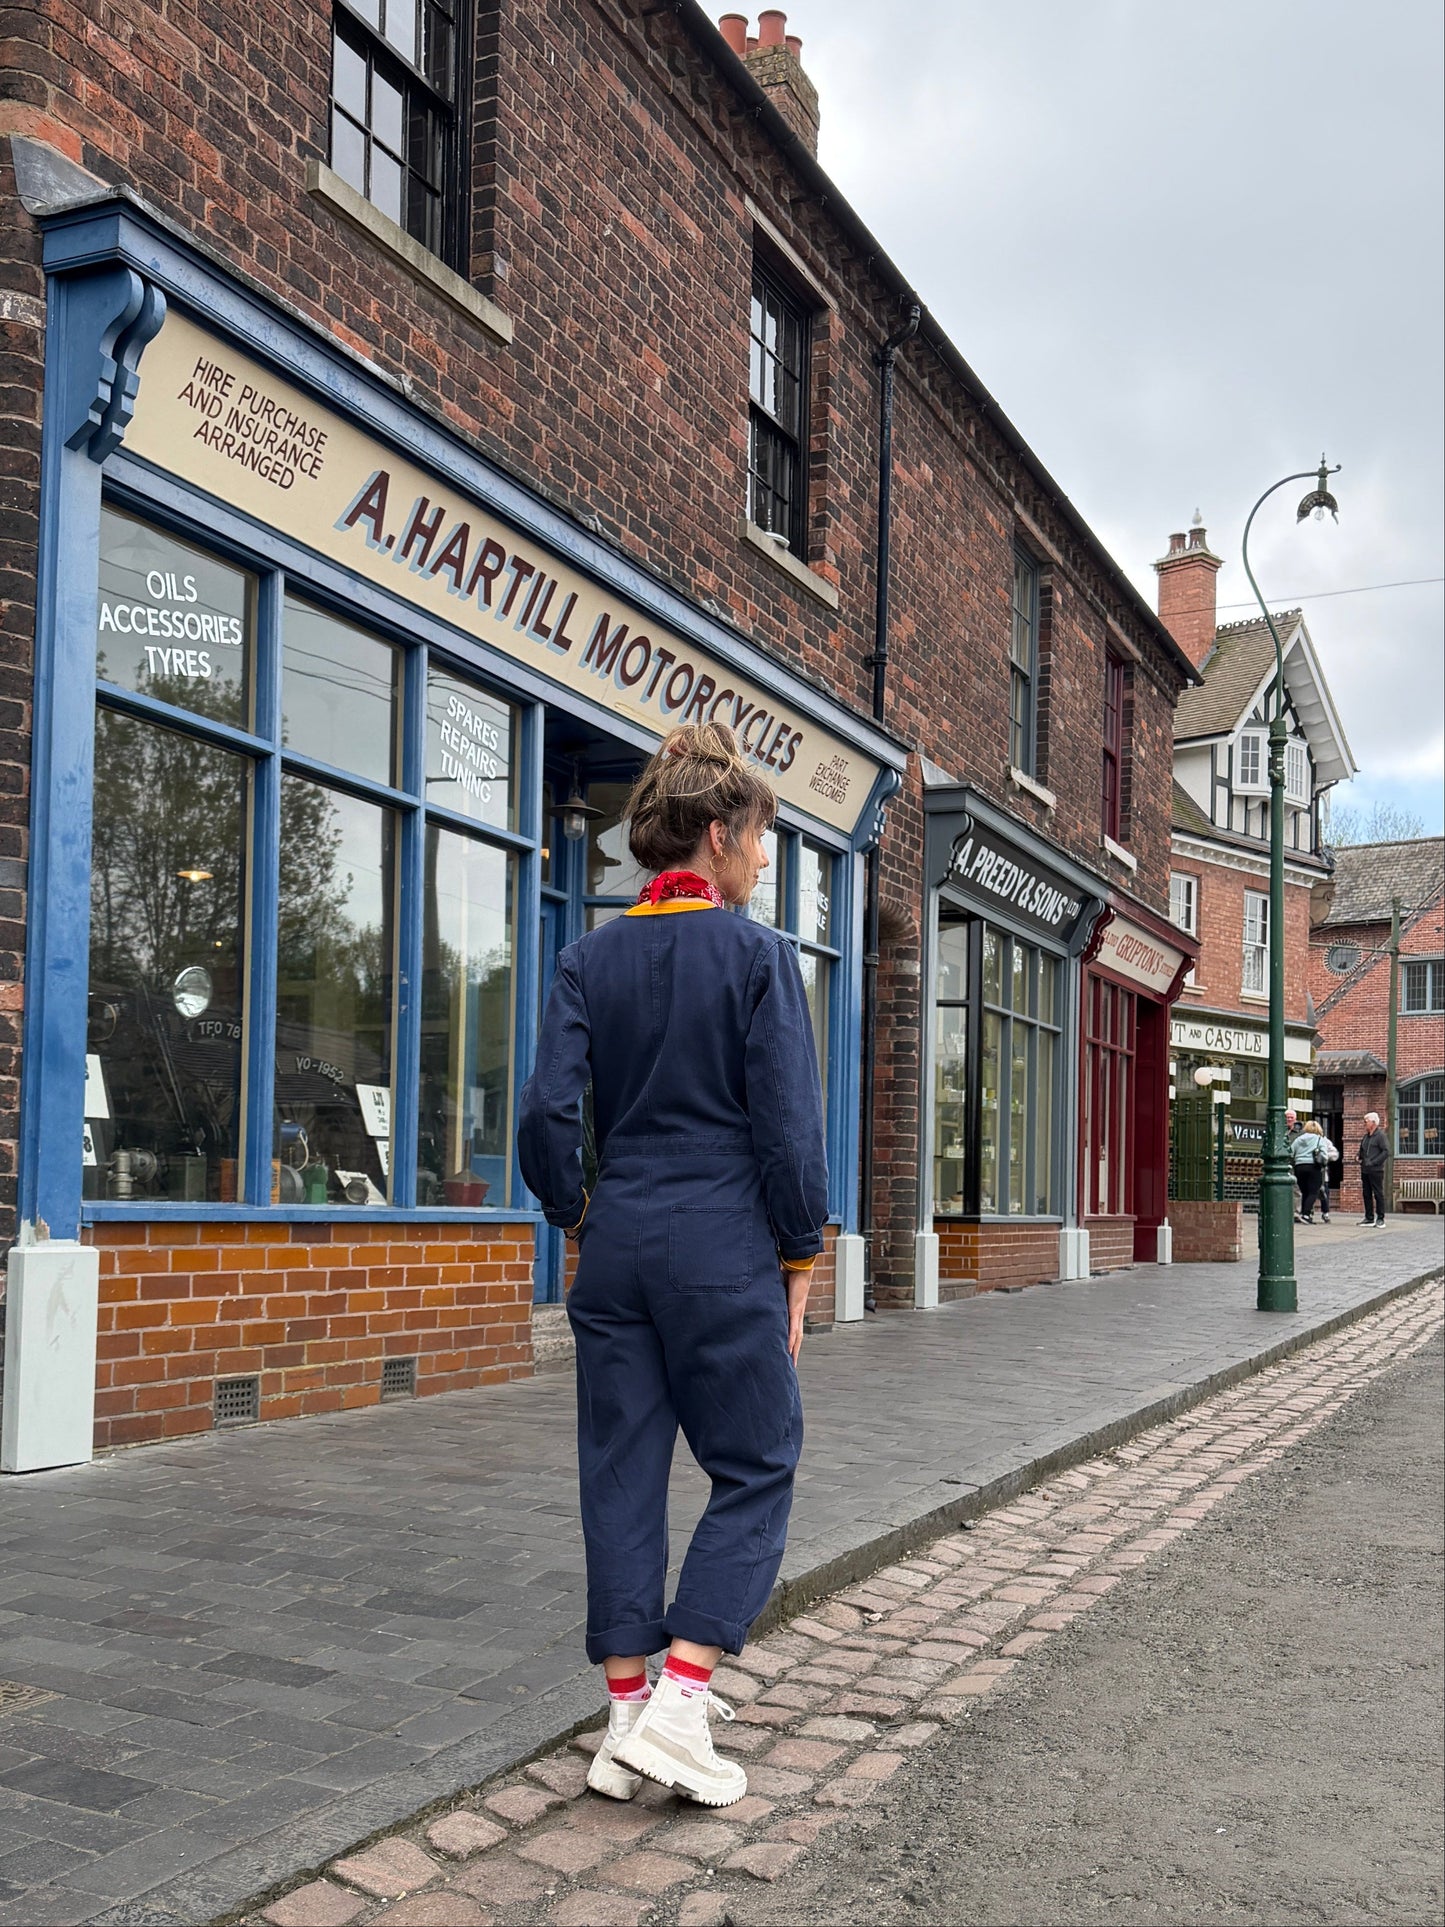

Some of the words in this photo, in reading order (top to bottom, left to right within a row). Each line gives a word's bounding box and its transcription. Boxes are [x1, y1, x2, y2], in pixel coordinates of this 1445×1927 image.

[192, 356, 236, 398] HIRE
[237, 384, 328, 455] PURCHASE
[177, 381, 223, 419] AND
[224, 407, 324, 480] INSURANCE
[193, 420, 295, 490] ARRANGED
[336, 470, 579, 654] A.HARTILL
[146, 570, 198, 603] OILS
[98, 602, 243, 645] ACCESSORIES
[144, 645, 212, 678] TYRES
[446, 695, 499, 751] SPARES
[440, 719, 498, 779] REPAIRS
[830, 754, 849, 773] PART
[440, 749, 492, 803] TUNING
[809, 775, 846, 805] WELCOMED
[815, 762, 851, 791] EXCHANGE
[1188, 1029, 1202, 1039] AND
[1205, 1027, 1262, 1053] CASTLE
[1233, 1125, 1266, 1140] VAUL
